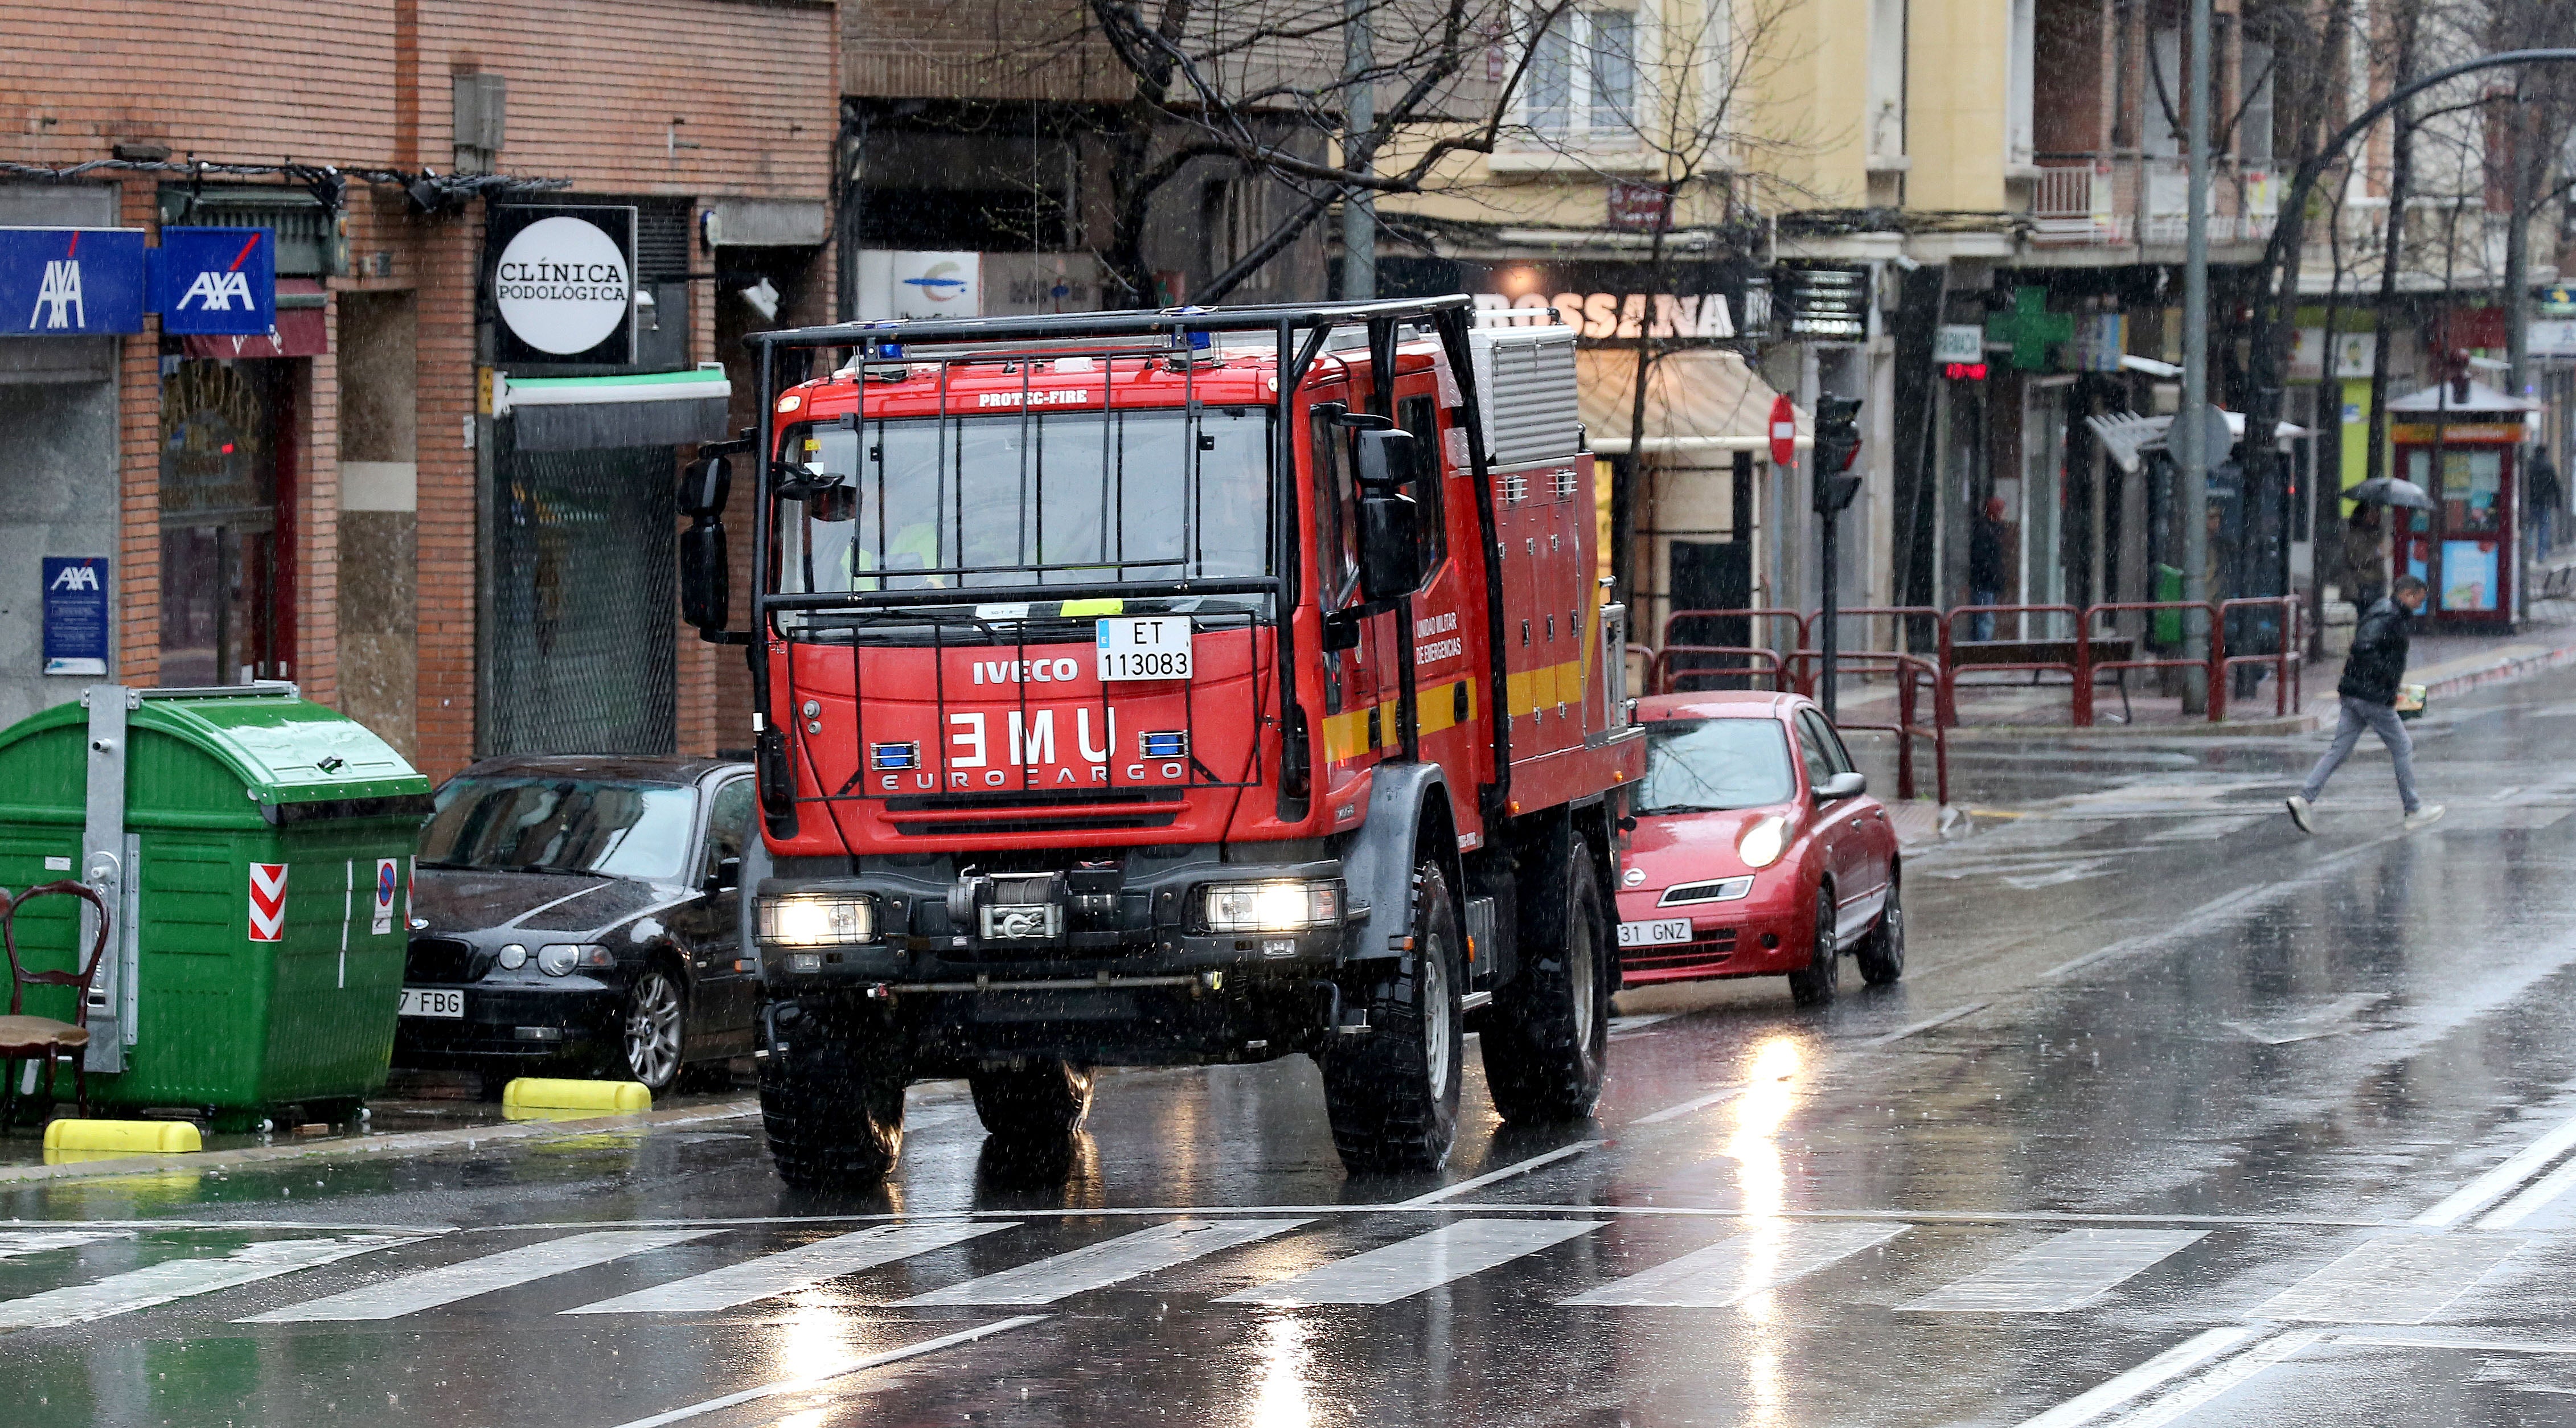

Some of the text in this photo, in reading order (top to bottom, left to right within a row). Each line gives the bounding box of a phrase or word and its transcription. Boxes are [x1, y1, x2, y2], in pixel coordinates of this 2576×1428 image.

[501, 257, 622, 282] CLÍNICA
[29, 260, 85, 330] AXA
[176, 271, 255, 311] AXA
[499, 281, 625, 301] PODOLÓGICA
[1472, 292, 1735, 339] ROSSANA
[979, 389, 1088, 407] PROTEC-FIRE
[50, 567, 99, 591] AXA
[1134, 621, 1163, 645] ET
[1435, 612, 1458, 634] MILITAR
[1416, 637, 1462, 665] DE EMERGENCIAS
[973, 657, 1079, 684] IVECO
[1105, 653, 1187, 676] 113083
[1654, 922, 1685, 940] GNZ
[421, 992, 459, 1012] FBG
